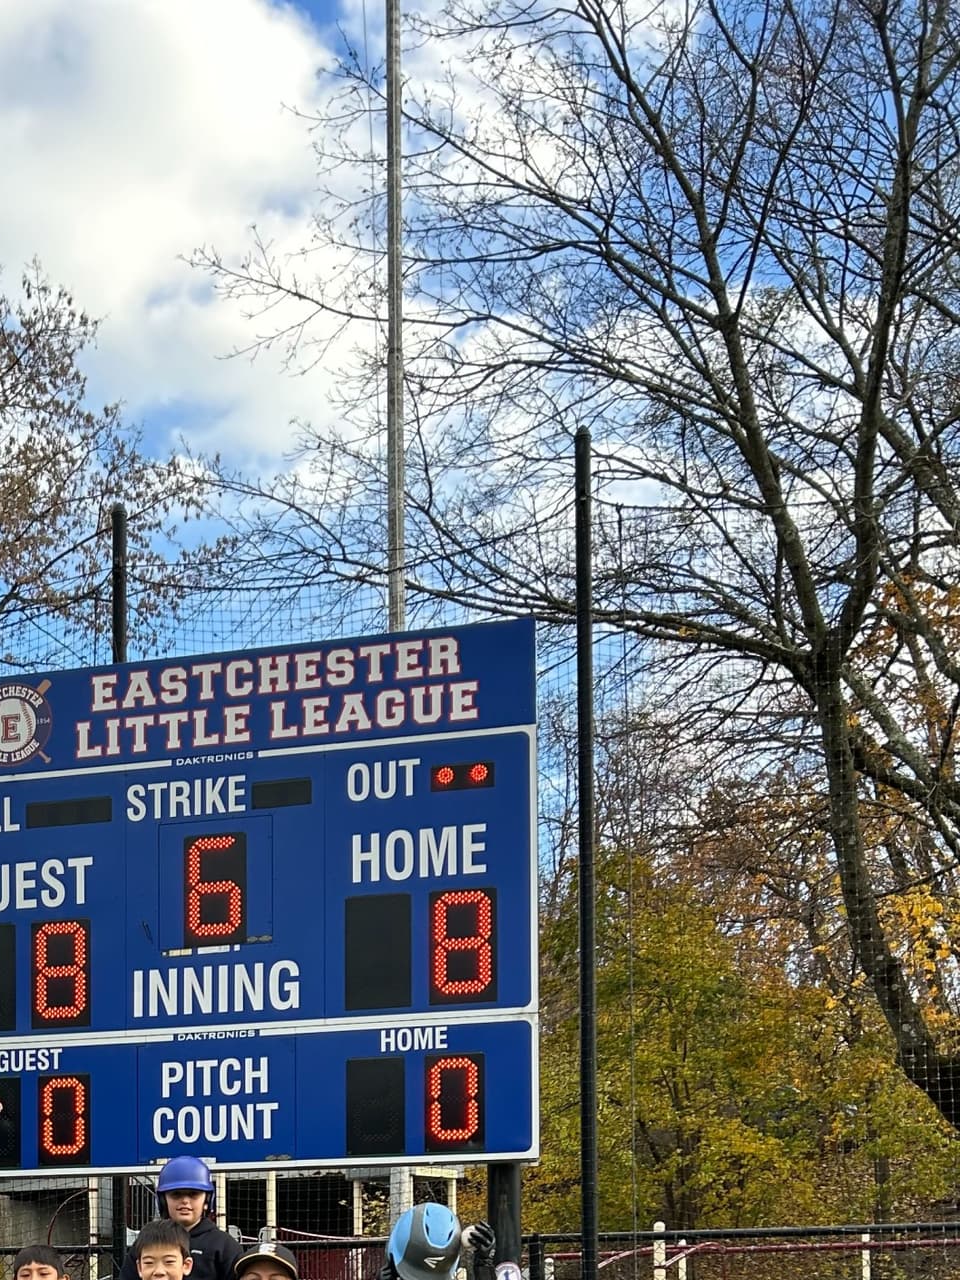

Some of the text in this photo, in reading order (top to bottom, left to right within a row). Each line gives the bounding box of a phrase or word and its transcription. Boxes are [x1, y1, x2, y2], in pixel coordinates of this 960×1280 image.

[91, 637, 462, 712] EASTCHESTER
[1, 714, 20, 743] E
[76, 680, 479, 759] LITTLE LEAGUE
[10, 739, 39, 762] LEAGUE
[176, 751, 254, 766] DAKTRONICS
[127, 776, 246, 821] STRIKE
[347, 758, 420, 801] OUT
[352, 824, 487, 882] HOME
[189, 836, 242, 937] 6
[433, 890, 492, 995] 8
[35, 921, 87, 1019] 8
[133, 960, 300, 1018] INNING
[178, 1030, 255, 1041] DAKTRONICS
[380, 1026, 448, 1052] HOME
[161, 1057, 269, 1098] PITCH
[429, 1057, 479, 1141] 0
[42, 1077, 85, 1155] 0
[153, 1102, 279, 1144] COUNT
